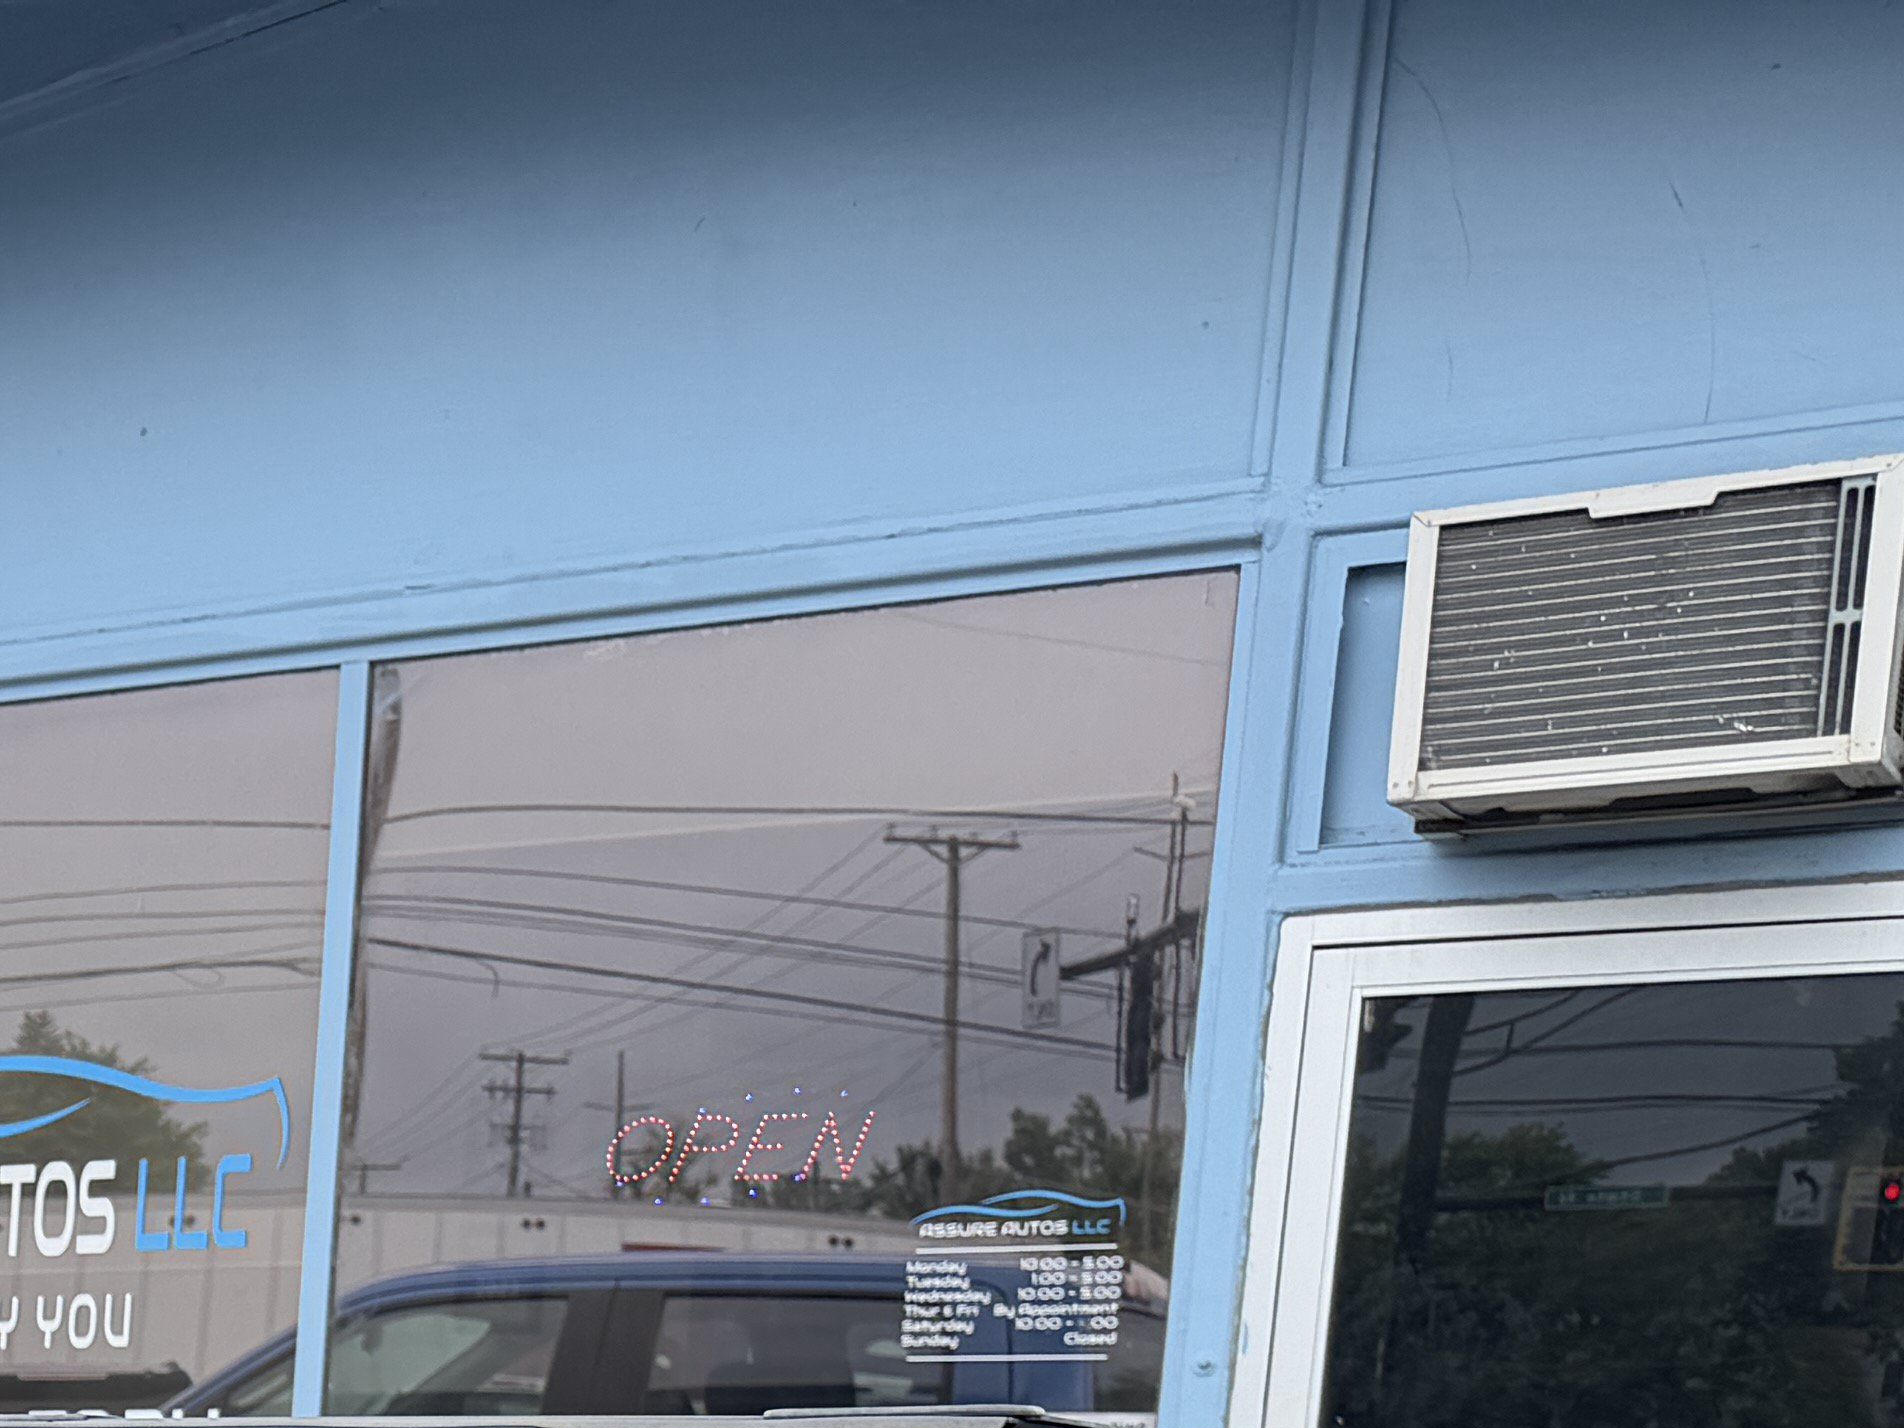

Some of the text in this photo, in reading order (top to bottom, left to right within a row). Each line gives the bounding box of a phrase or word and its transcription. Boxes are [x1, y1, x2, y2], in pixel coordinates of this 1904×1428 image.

[605, 1109, 878, 1184] OPEN
[134, 1154, 253, 1253] LLC
[919, 1218, 1112, 1239] ASSURE AUTOS LLC
[906, 1260, 968, 1276] Monday
[906, 1275, 971, 1290] Tuesday
[904, 1289, 991, 1305] Wednesday
[993, 1302, 1016, 1319] By
[1018, 1302, 1119, 1317] Appointment
[36, 1293, 133, 1350] YOU
[901, 1318, 975, 1335] Saturday
[900, 1332, 1118, 1350] Sunday Closed
